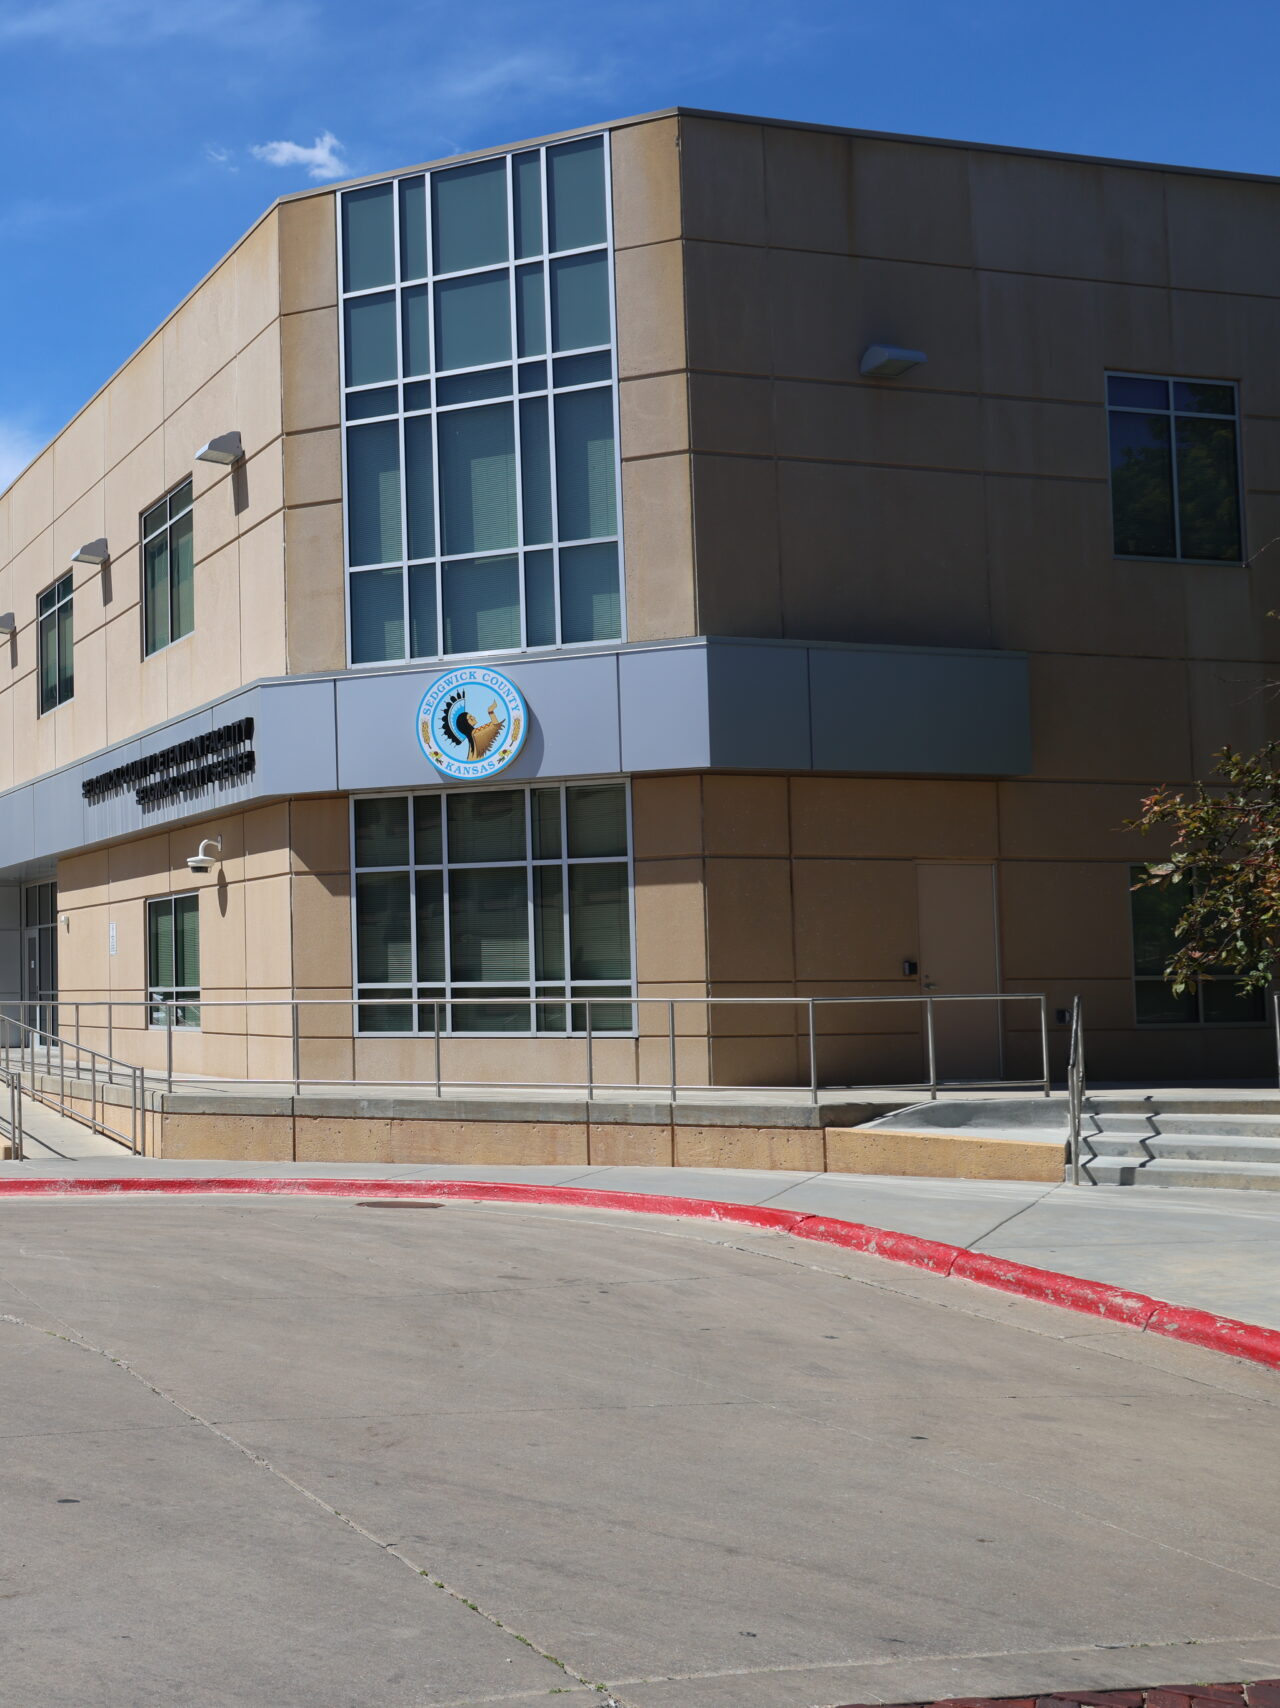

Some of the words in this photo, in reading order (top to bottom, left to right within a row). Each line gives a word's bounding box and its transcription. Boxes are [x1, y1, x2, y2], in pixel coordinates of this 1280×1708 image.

[422, 671, 477, 715] SEDGWICK
[482, 673, 520, 712] COUNTY
[445, 761, 496, 775] KANSAS
